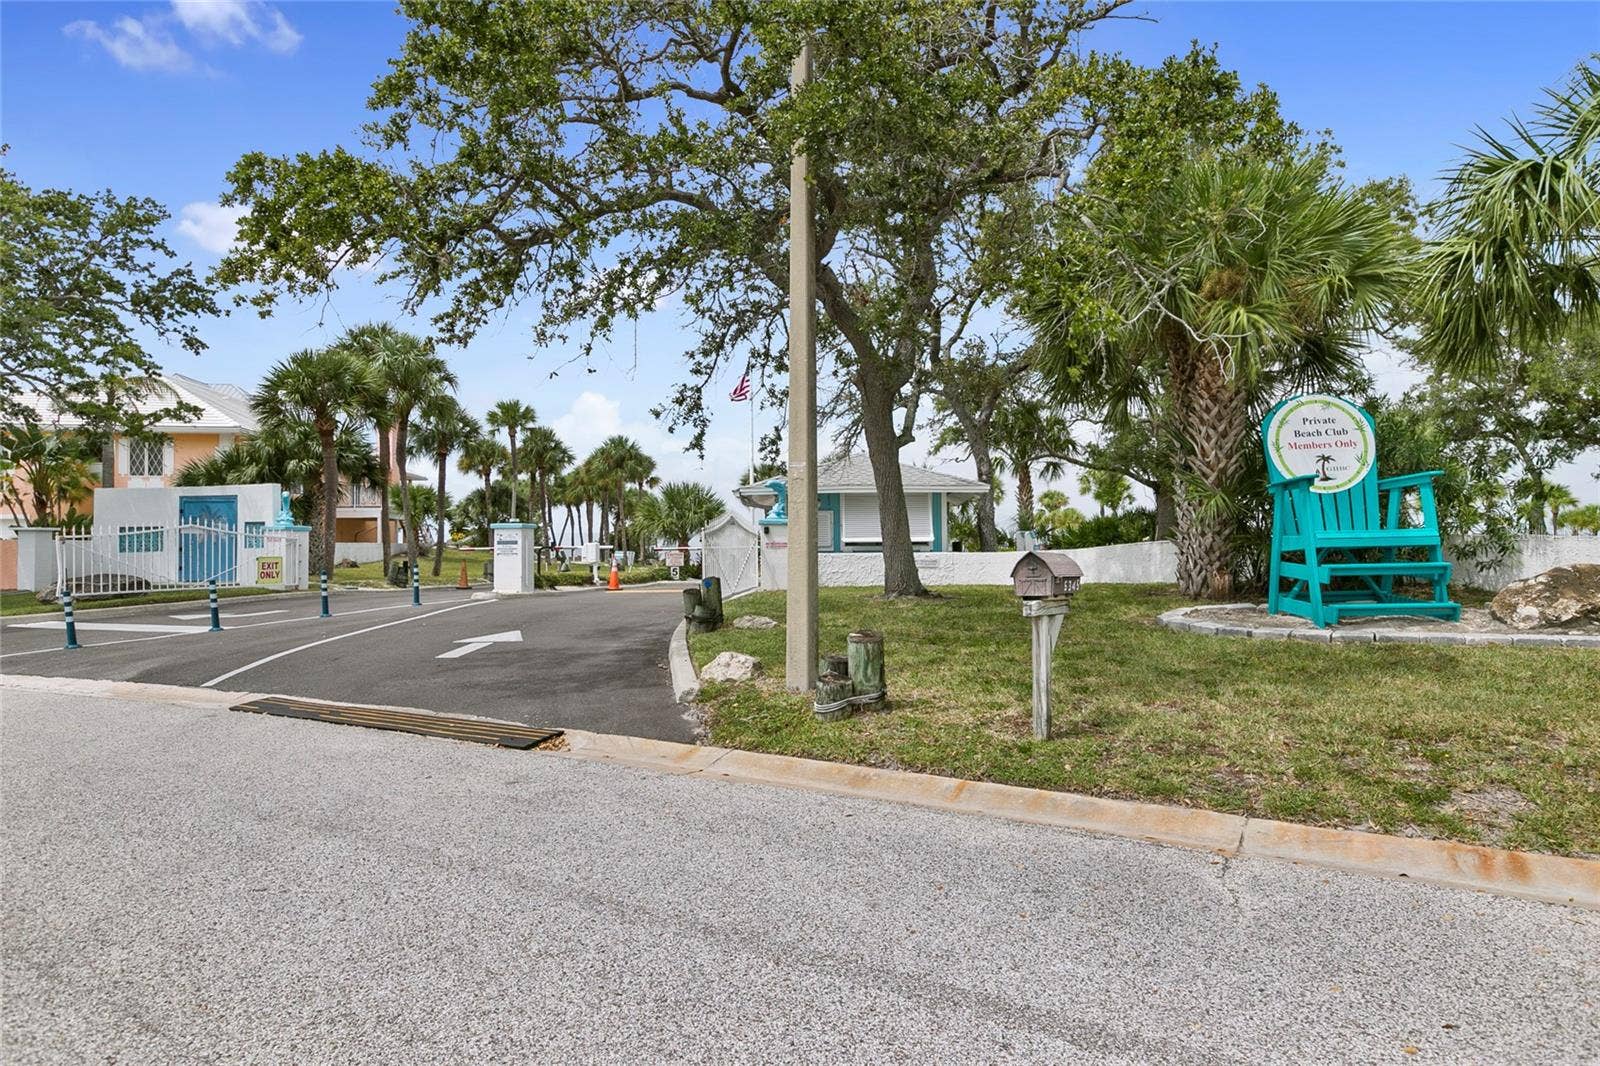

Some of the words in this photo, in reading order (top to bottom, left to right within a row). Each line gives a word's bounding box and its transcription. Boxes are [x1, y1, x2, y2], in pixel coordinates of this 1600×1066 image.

[1302, 417, 1336, 425] Private
[1294, 429, 1322, 438] Beach
[1325, 428, 1348, 436] Club
[1288, 441, 1332, 450] Members
[1335, 440, 1358, 449] Only
[261, 562, 279, 570] EXIT
[260, 571, 280, 579] ONLY
[672, 567, 678, 576] 5
